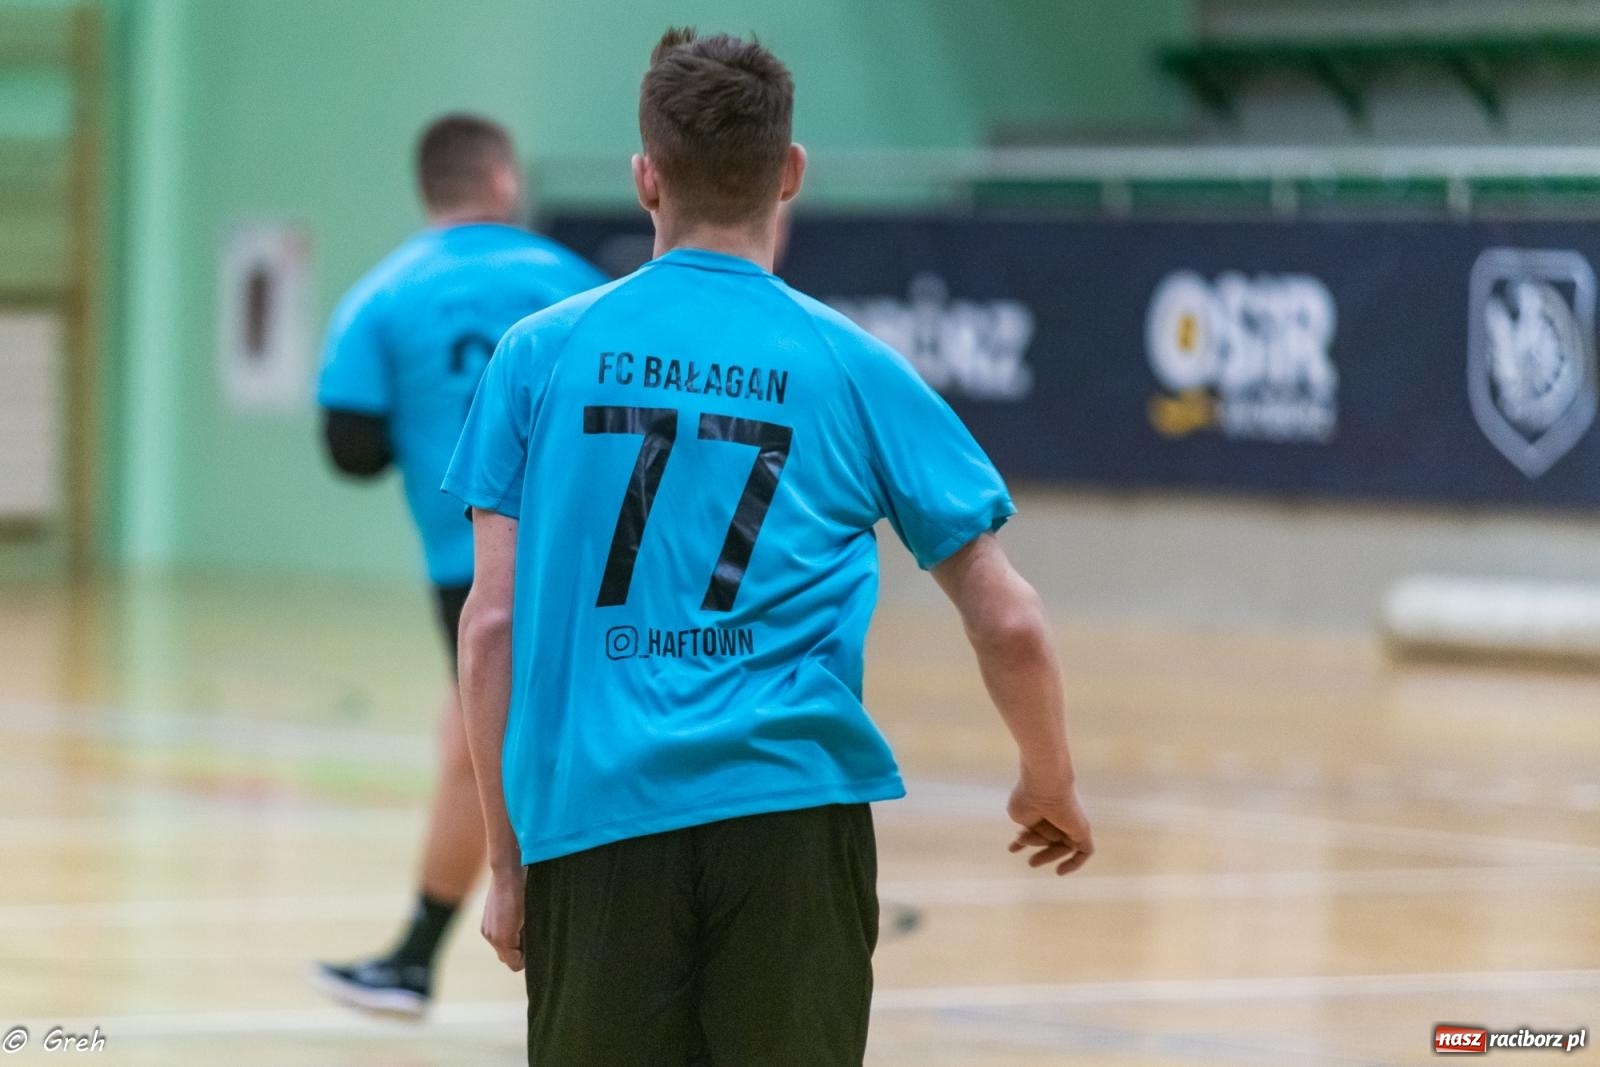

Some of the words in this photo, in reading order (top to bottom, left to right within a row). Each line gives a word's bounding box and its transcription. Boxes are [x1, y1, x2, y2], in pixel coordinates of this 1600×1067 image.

[598, 352, 634, 385] FC
[643, 356, 789, 405] BAŁAGAN
[583, 406, 793, 612] 77
